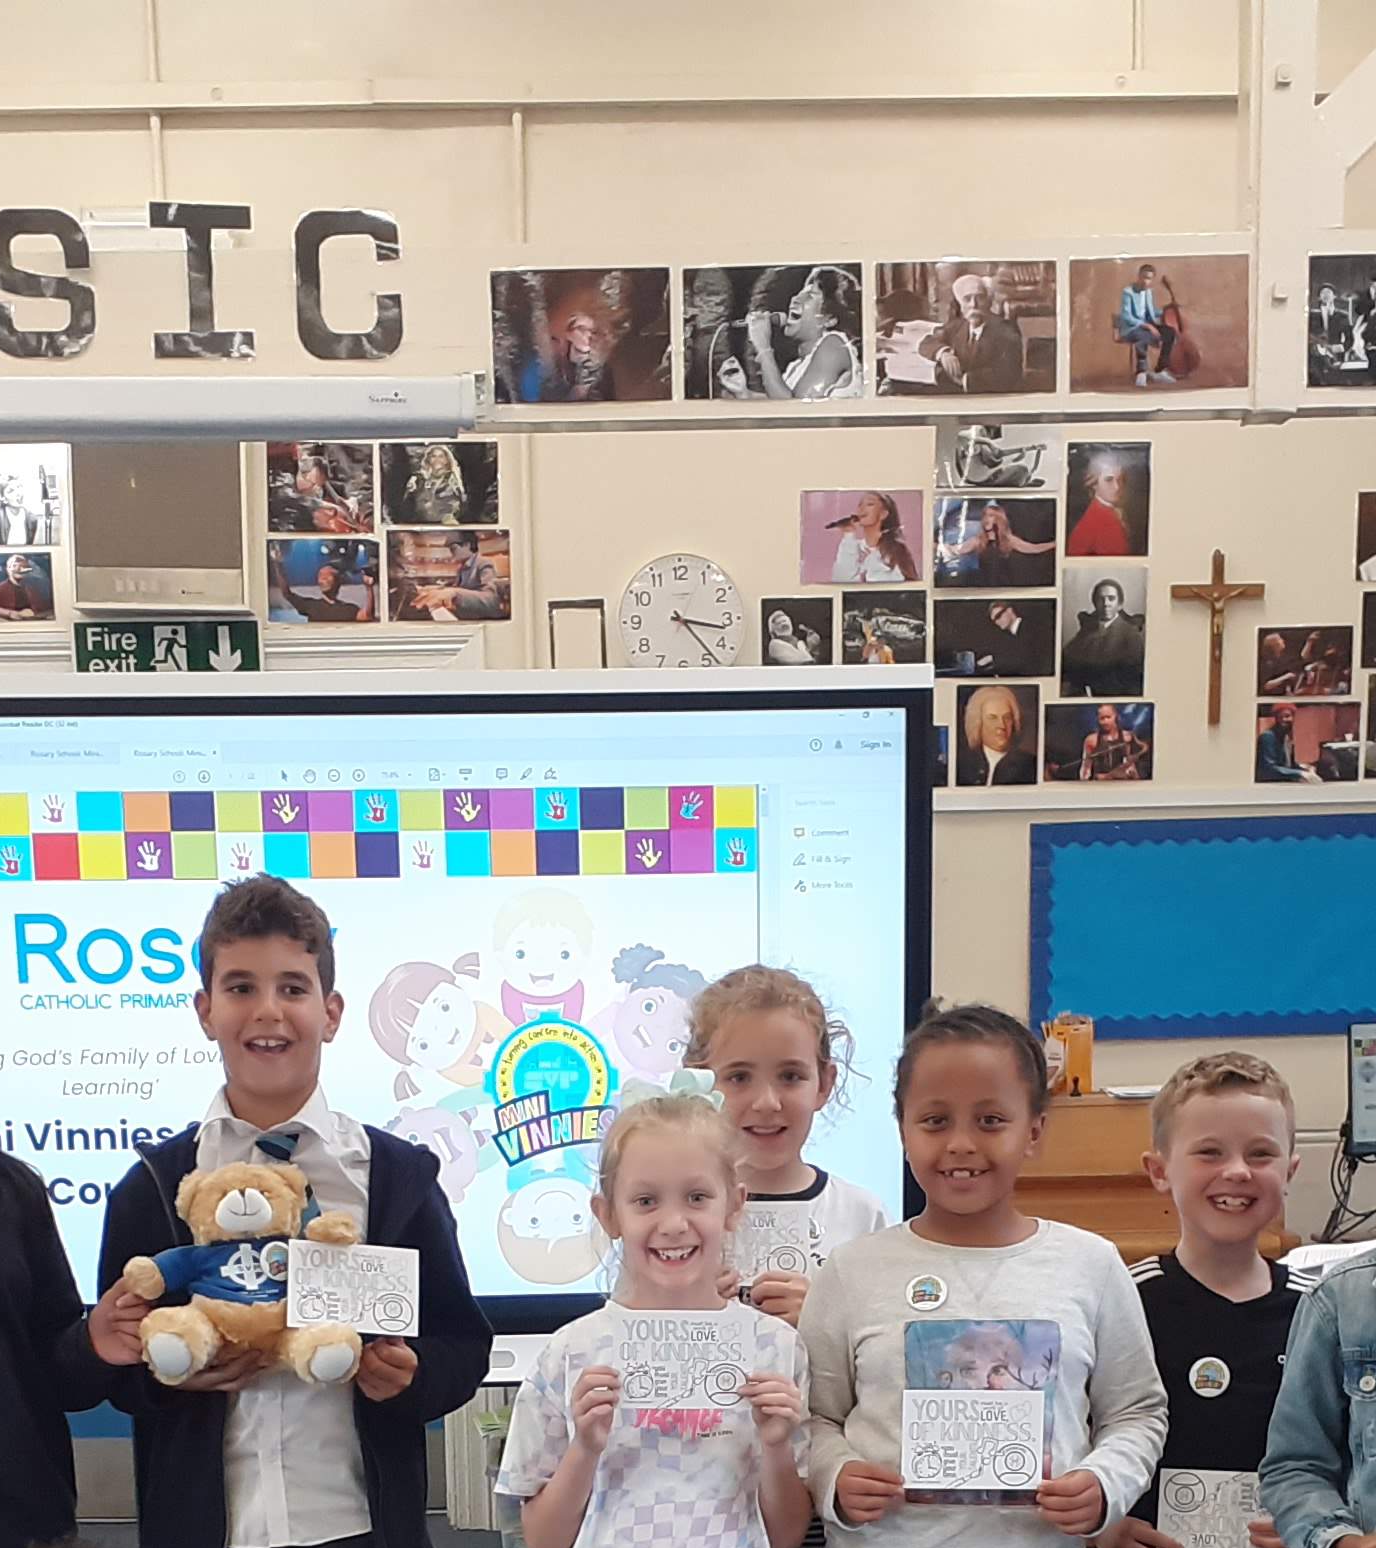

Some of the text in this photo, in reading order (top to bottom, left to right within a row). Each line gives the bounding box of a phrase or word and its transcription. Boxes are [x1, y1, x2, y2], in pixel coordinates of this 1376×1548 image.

[651, 573, 663, 588] 11
[672, 565, 689, 581] 12
[634, 591, 652, 607] 10
[715, 588, 727, 603] 2
[630, 615, 642, 631] 9
[722, 612, 734, 628] 3
[86, 627, 138, 651] Fire
[638, 637, 651, 653] 8
[715, 636, 727, 650] 4
[88, 653, 138, 673] exit
[655, 655, 666, 668] 7
[701, 653, 712, 668] 5
[14, 912, 224, 985] Ros
[19, 993, 112, 1010] CATHOLIC
[12, 1049, 73, 1067] God's
[80, 1047, 146, 1070] Family
[156, 1047, 178, 1065] of
[25, 1119, 175, 1152] Vinnies
[297, 1248, 361, 1271] YOURS
[622, 1319, 689, 1342] YOURS
[619, 1342, 646, 1362] OF
[911, 1399, 979, 1422] YOURS
[910, 1421, 932, 1441] OF
[940, 1422, 1037, 1442] KINDNESS.
